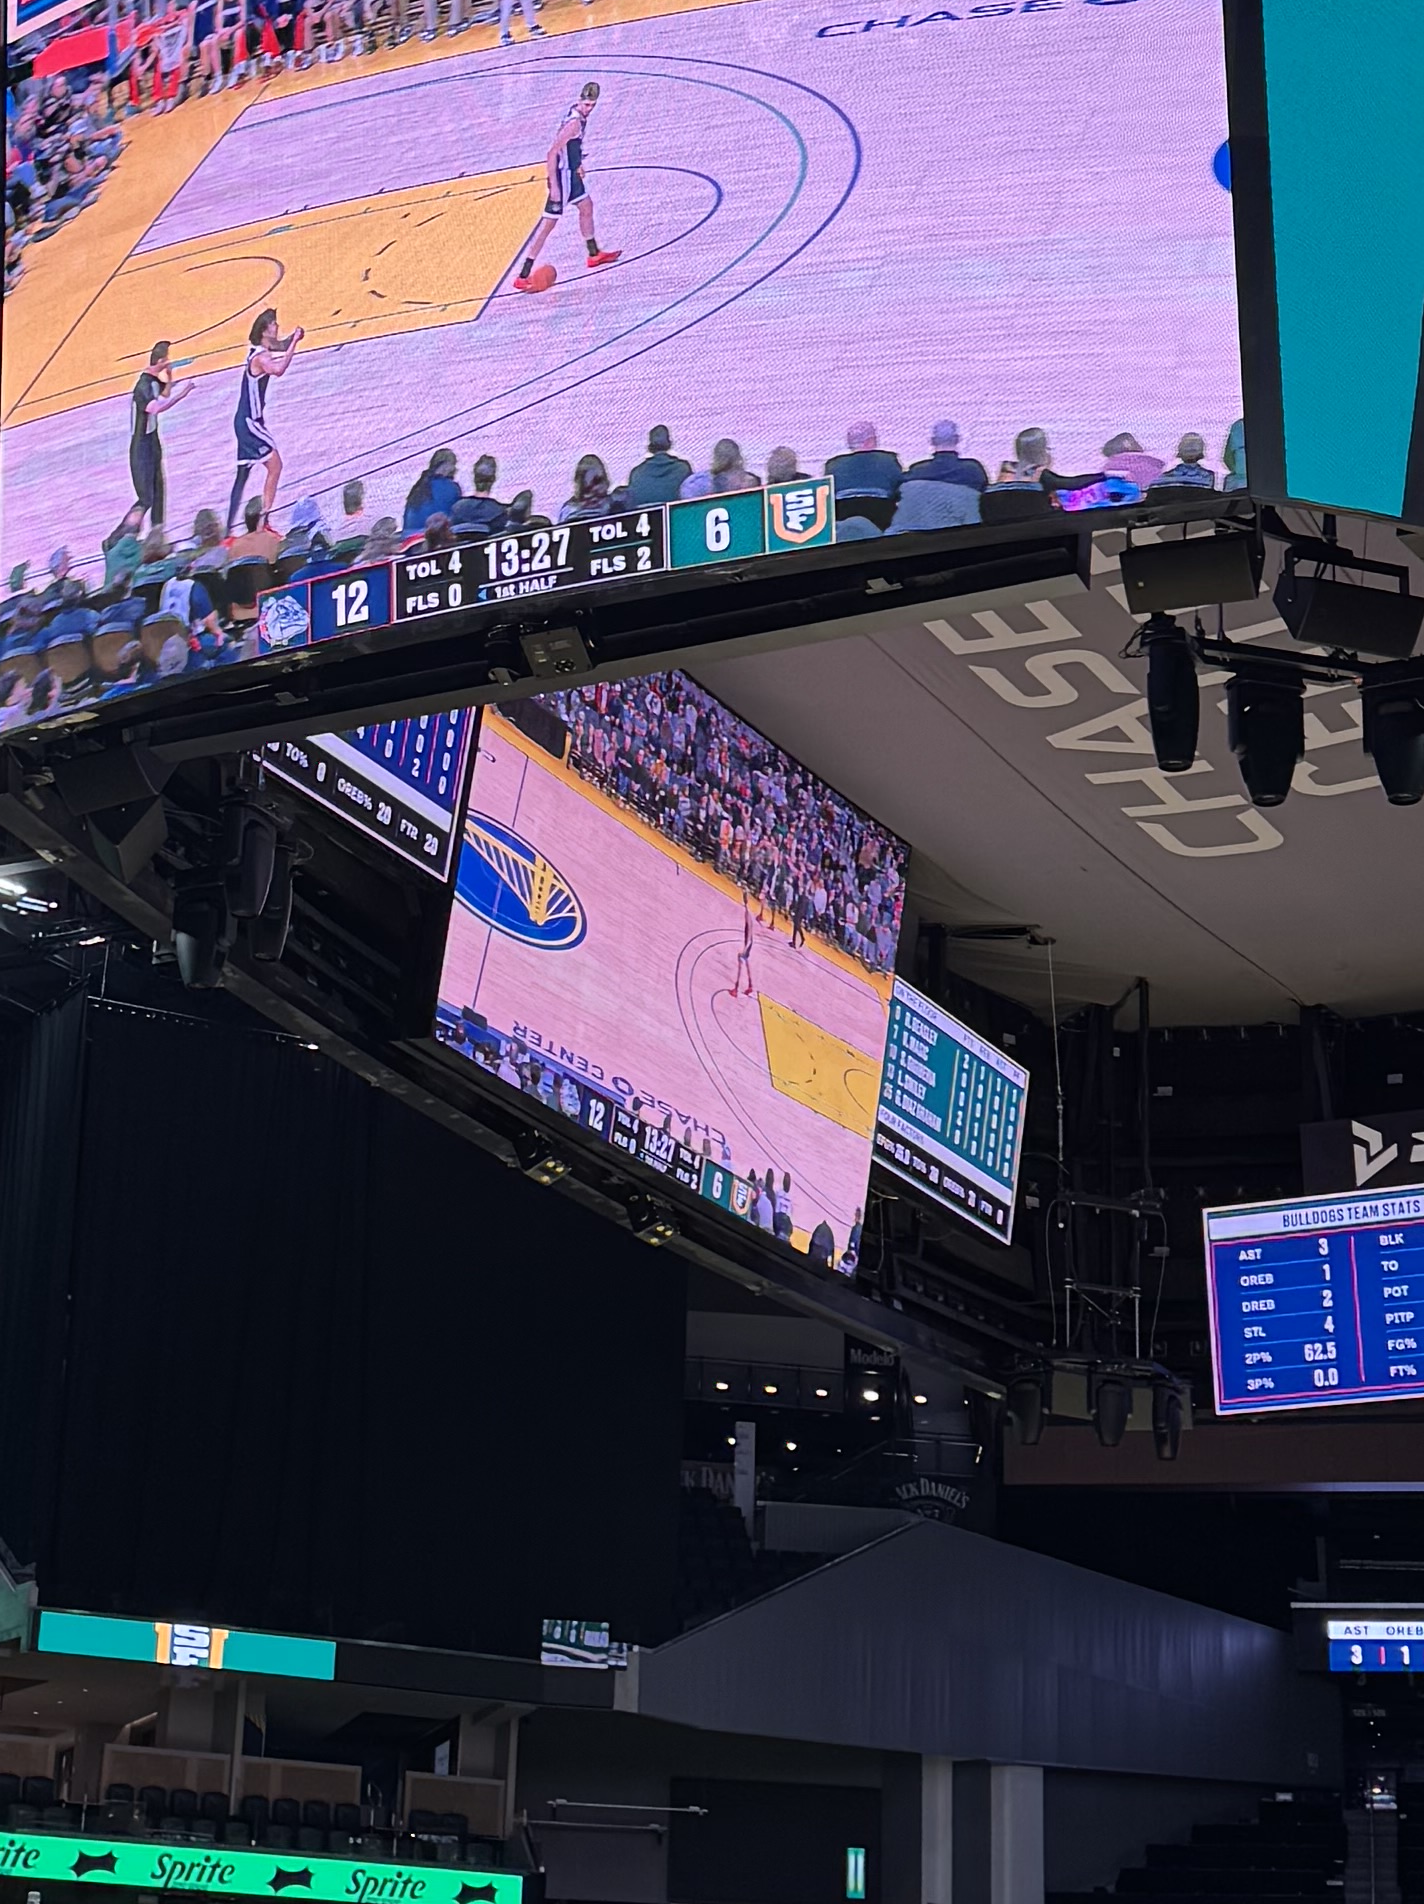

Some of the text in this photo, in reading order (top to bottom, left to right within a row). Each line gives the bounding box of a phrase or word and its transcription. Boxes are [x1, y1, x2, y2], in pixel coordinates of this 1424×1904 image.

[705, 507, 731, 553] 6
[484, 528, 571, 581] 13:27
[332, 580, 369, 627] 12
[518, 575, 558, 595] HALF
[923, 599, 1285, 858] CHASE
[1282, 1199, 1421, 1228] BULLDOGS TEAM STATS
